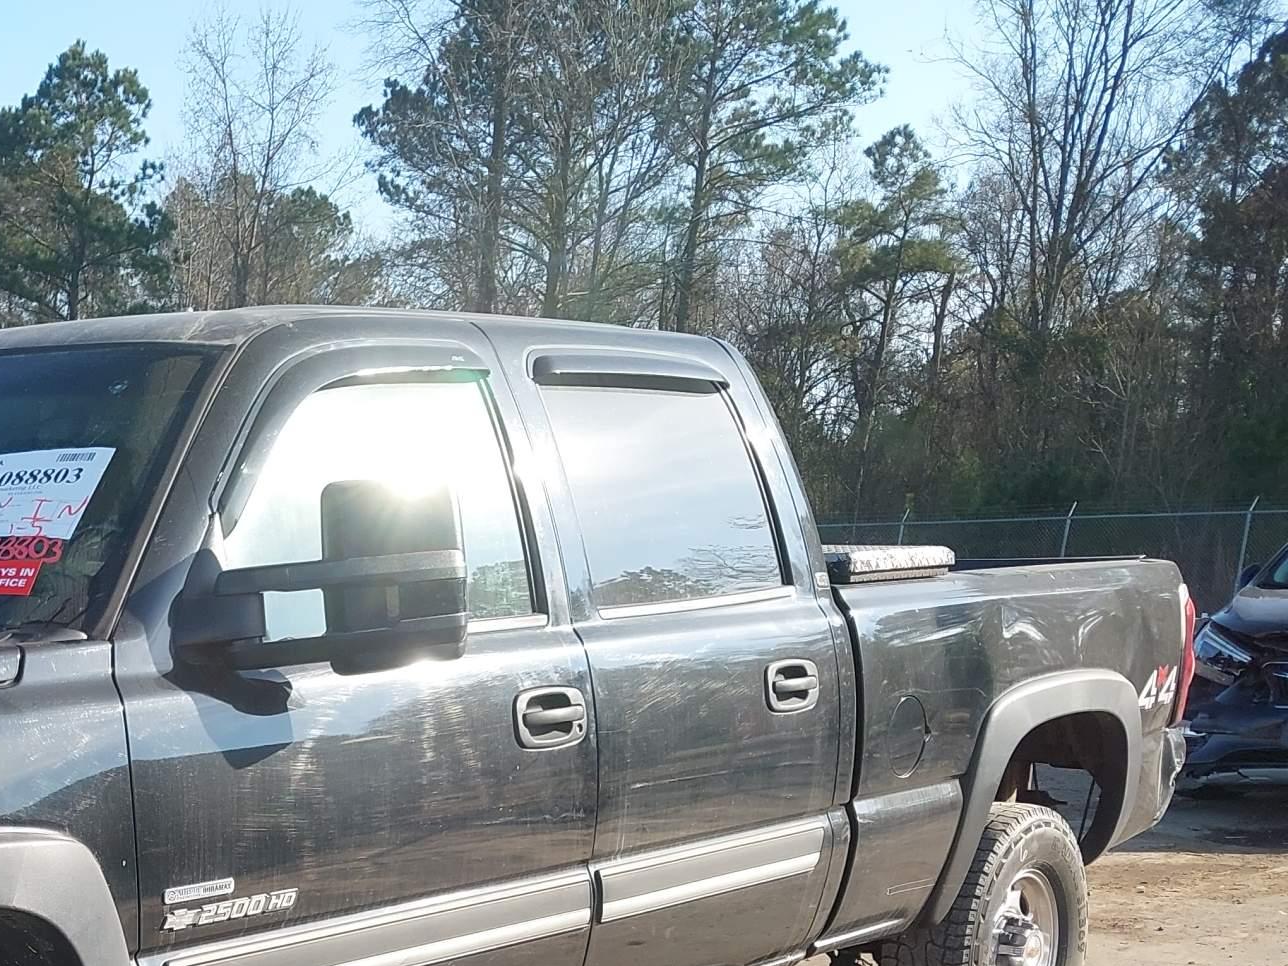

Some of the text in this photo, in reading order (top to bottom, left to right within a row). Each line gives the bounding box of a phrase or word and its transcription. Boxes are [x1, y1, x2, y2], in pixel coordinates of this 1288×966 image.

[19, 567, 35, 577] IN
[197, 889, 298, 925] 2500 HD
